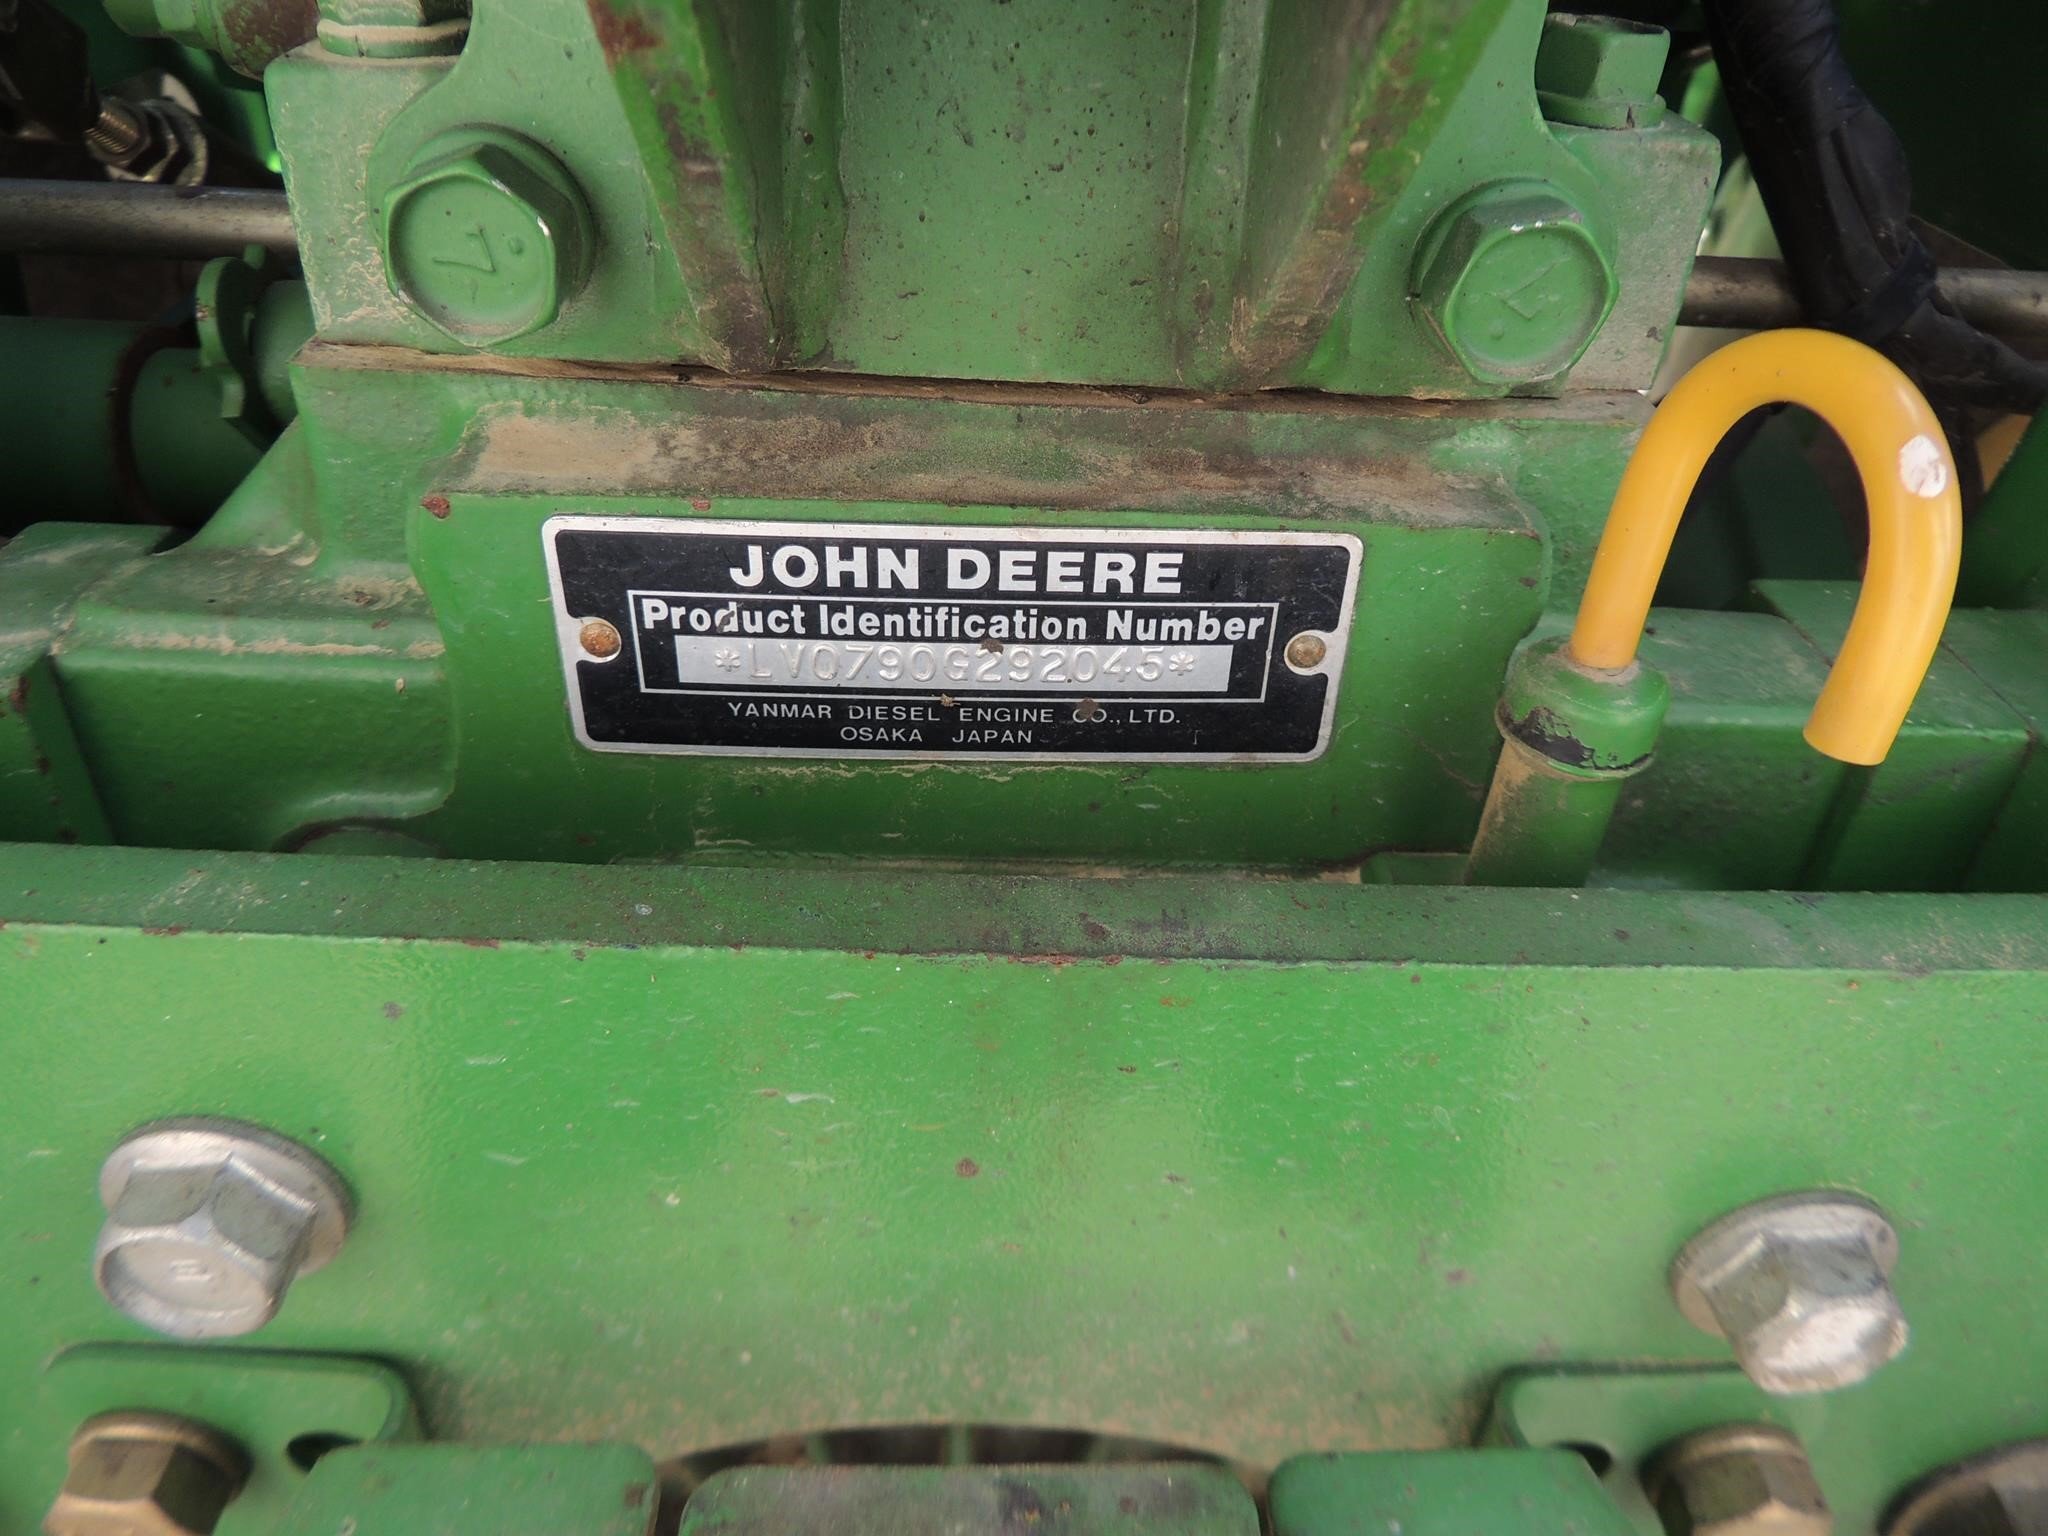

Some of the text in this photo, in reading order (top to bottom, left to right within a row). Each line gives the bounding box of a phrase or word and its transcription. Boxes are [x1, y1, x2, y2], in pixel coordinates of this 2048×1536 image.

[729, 545, 1184, 594] JOHN DEERE
[642, 598, 1265, 641] Product Identification Number
[728, 702, 832, 719] YANMAR
[848, 706, 940, 721] DIESEL
[959, 707, 1054, 723] ENGINE
[840, 727, 1032, 744] OSAKA JAPAN
